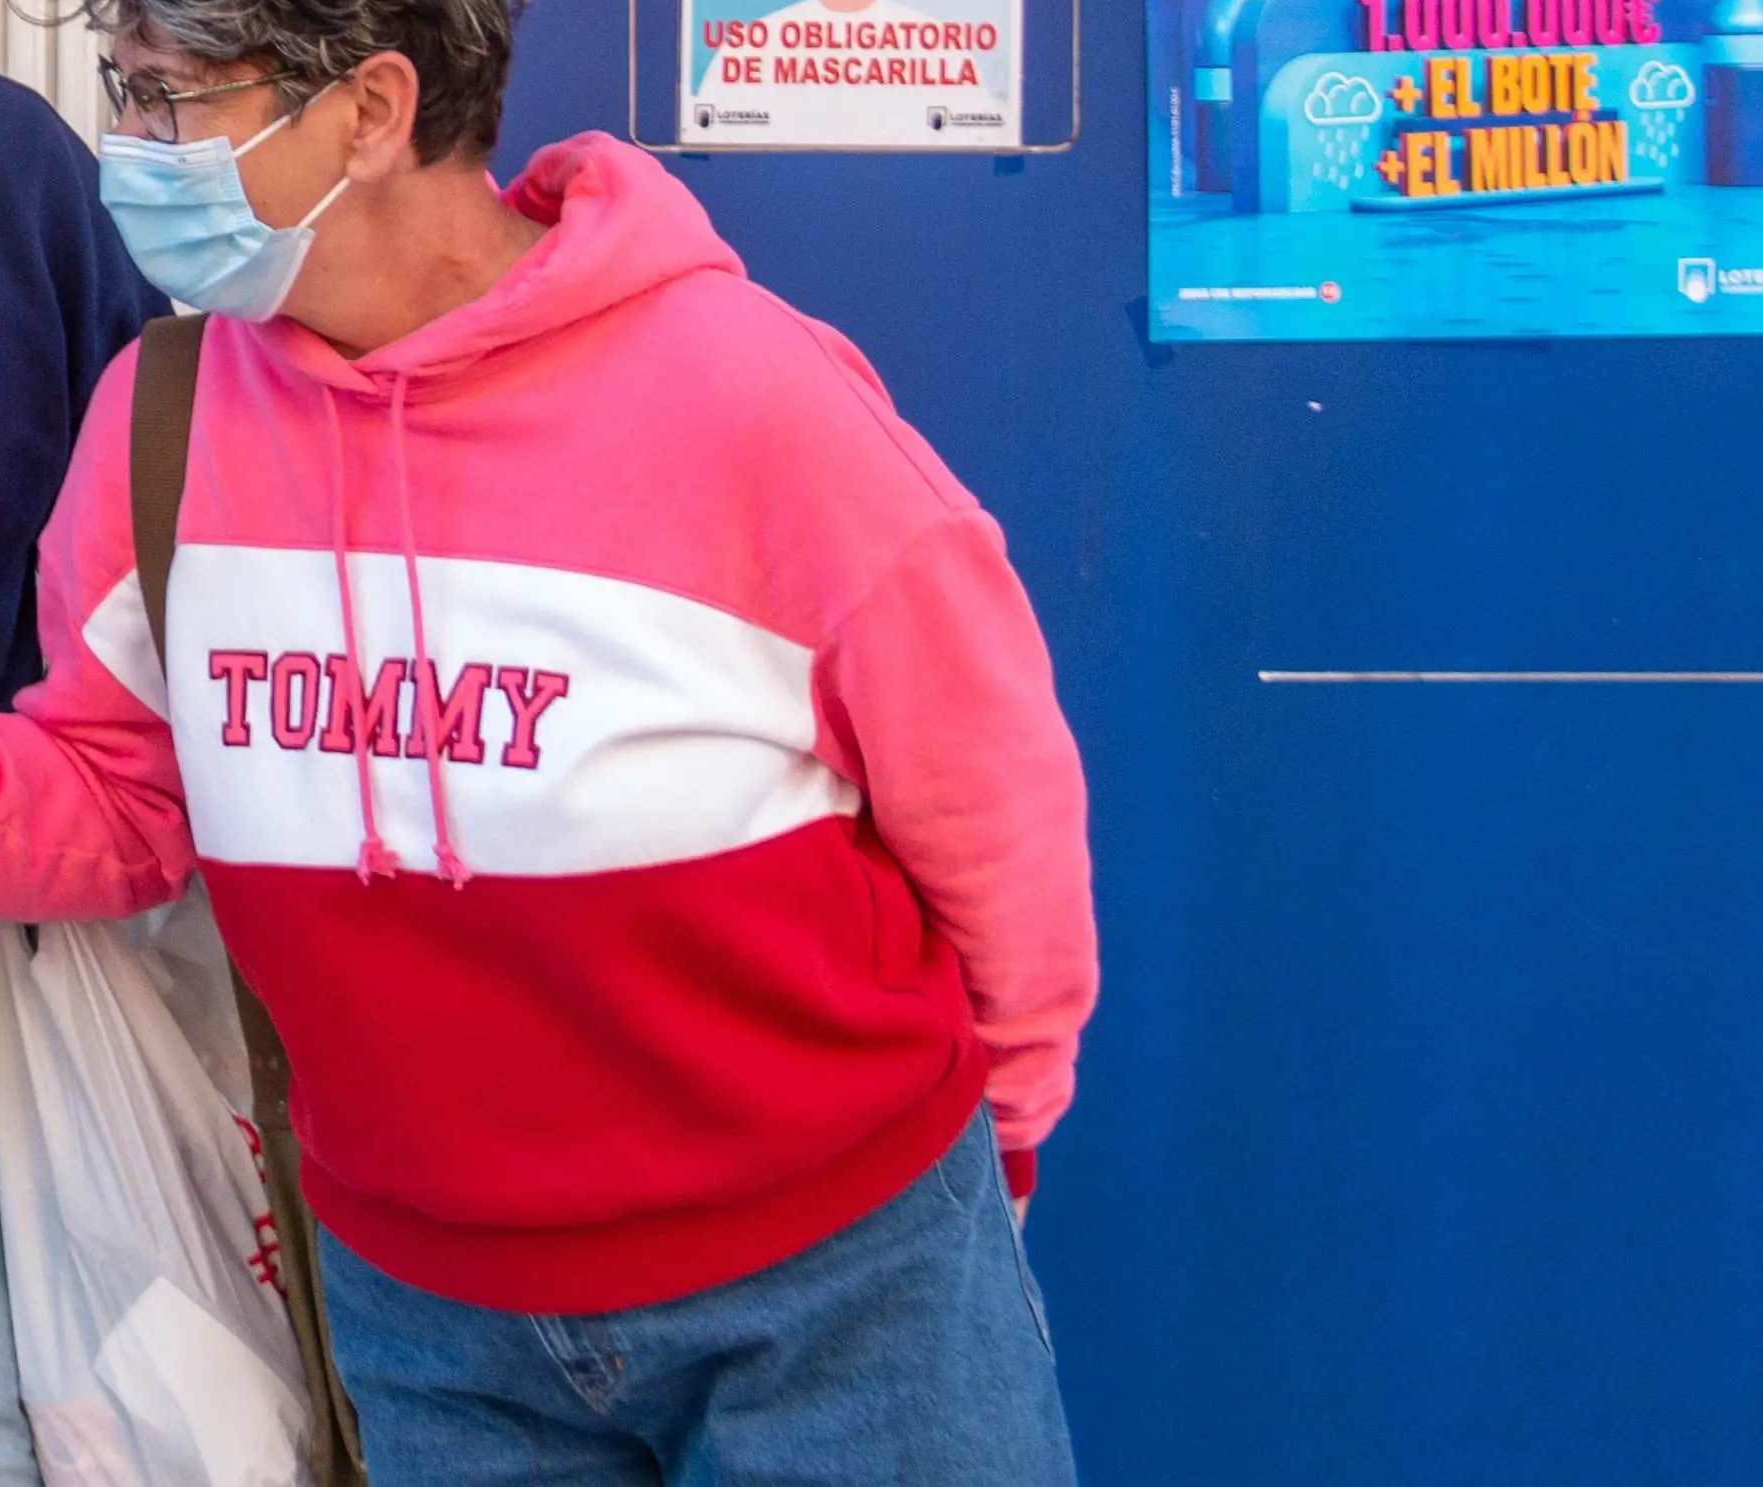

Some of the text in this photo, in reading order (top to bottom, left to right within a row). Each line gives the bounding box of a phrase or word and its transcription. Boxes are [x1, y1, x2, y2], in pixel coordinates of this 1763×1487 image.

[703, 20, 998, 51] USO OBLIGATORIO
[722, 56, 979, 86] DE MASCARILLA
[1484, 52, 1601, 119] BOTE
[1462, 110, 1630, 194] MILLÓN
[209, 648, 570, 771] TOMMY
